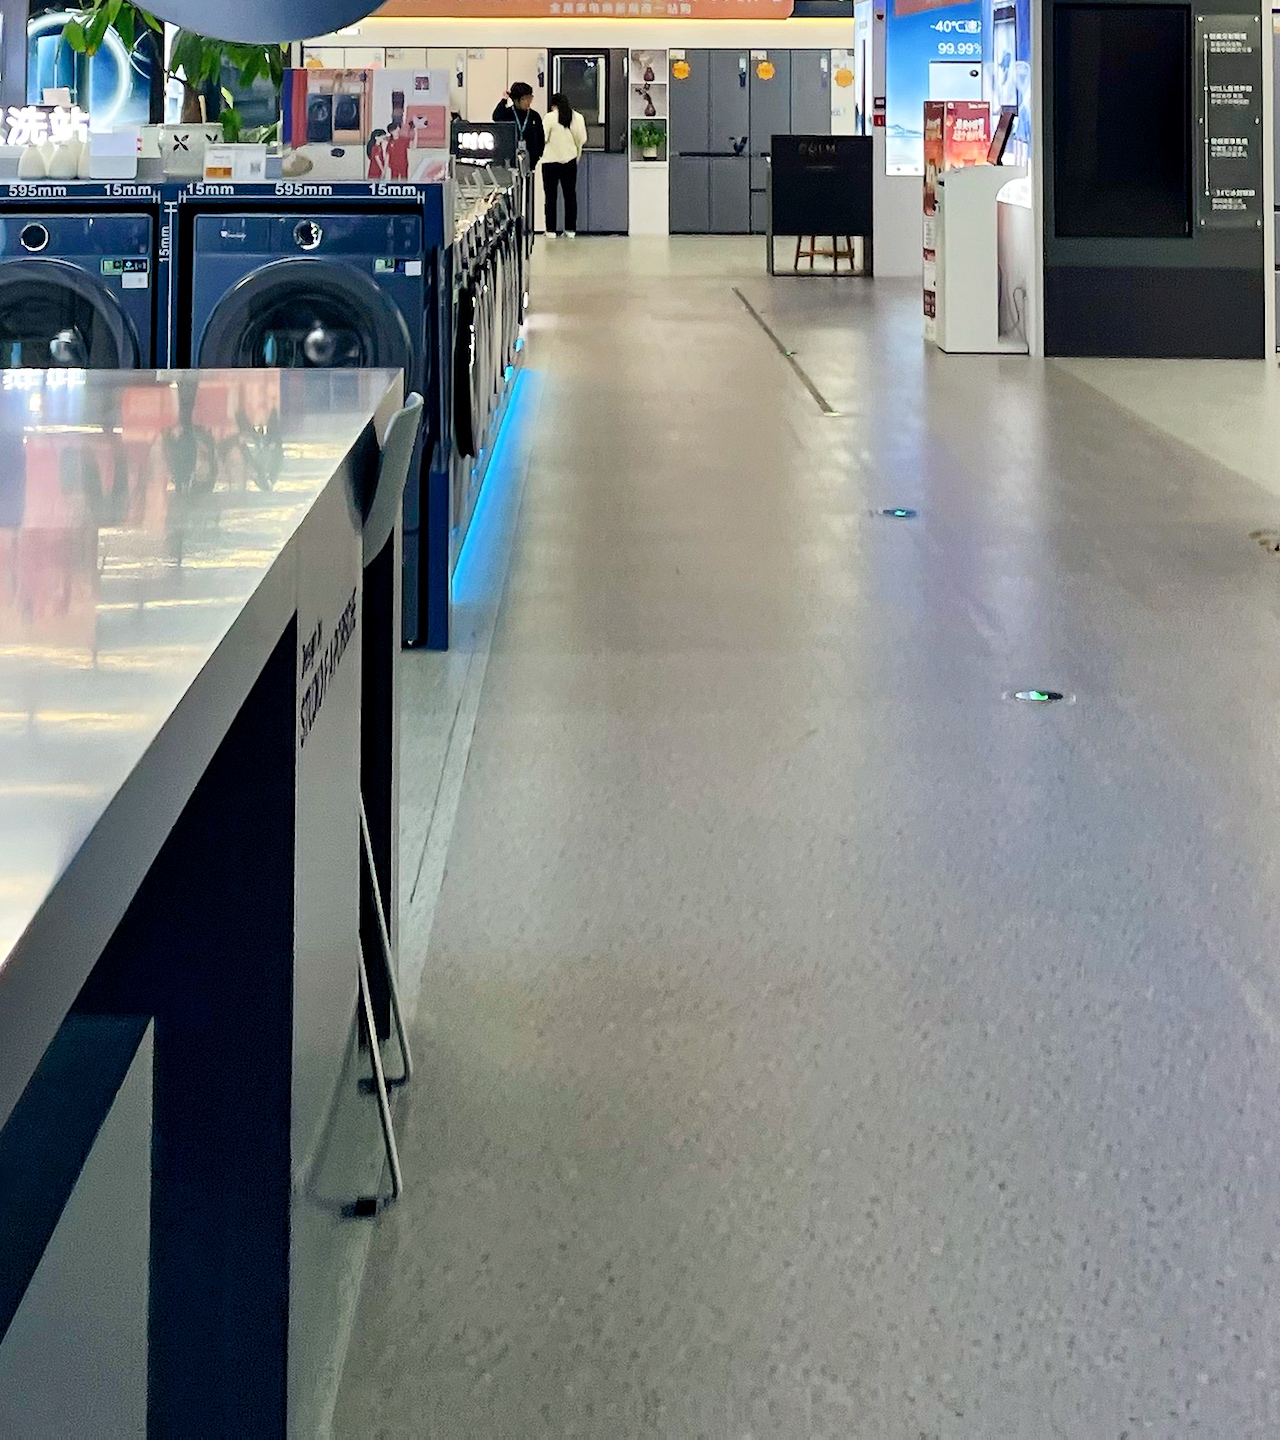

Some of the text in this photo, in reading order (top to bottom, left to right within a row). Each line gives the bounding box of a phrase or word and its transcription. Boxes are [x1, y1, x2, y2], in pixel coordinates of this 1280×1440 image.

[937, 42, 983, 56] 99.99%
[8, 183, 67, 198] 595mm
[103, 182, 152, 197] 15mm
[186, 183, 417, 198] 15mm 595mm 15mm
[159, 223, 171, 264] 15mm
